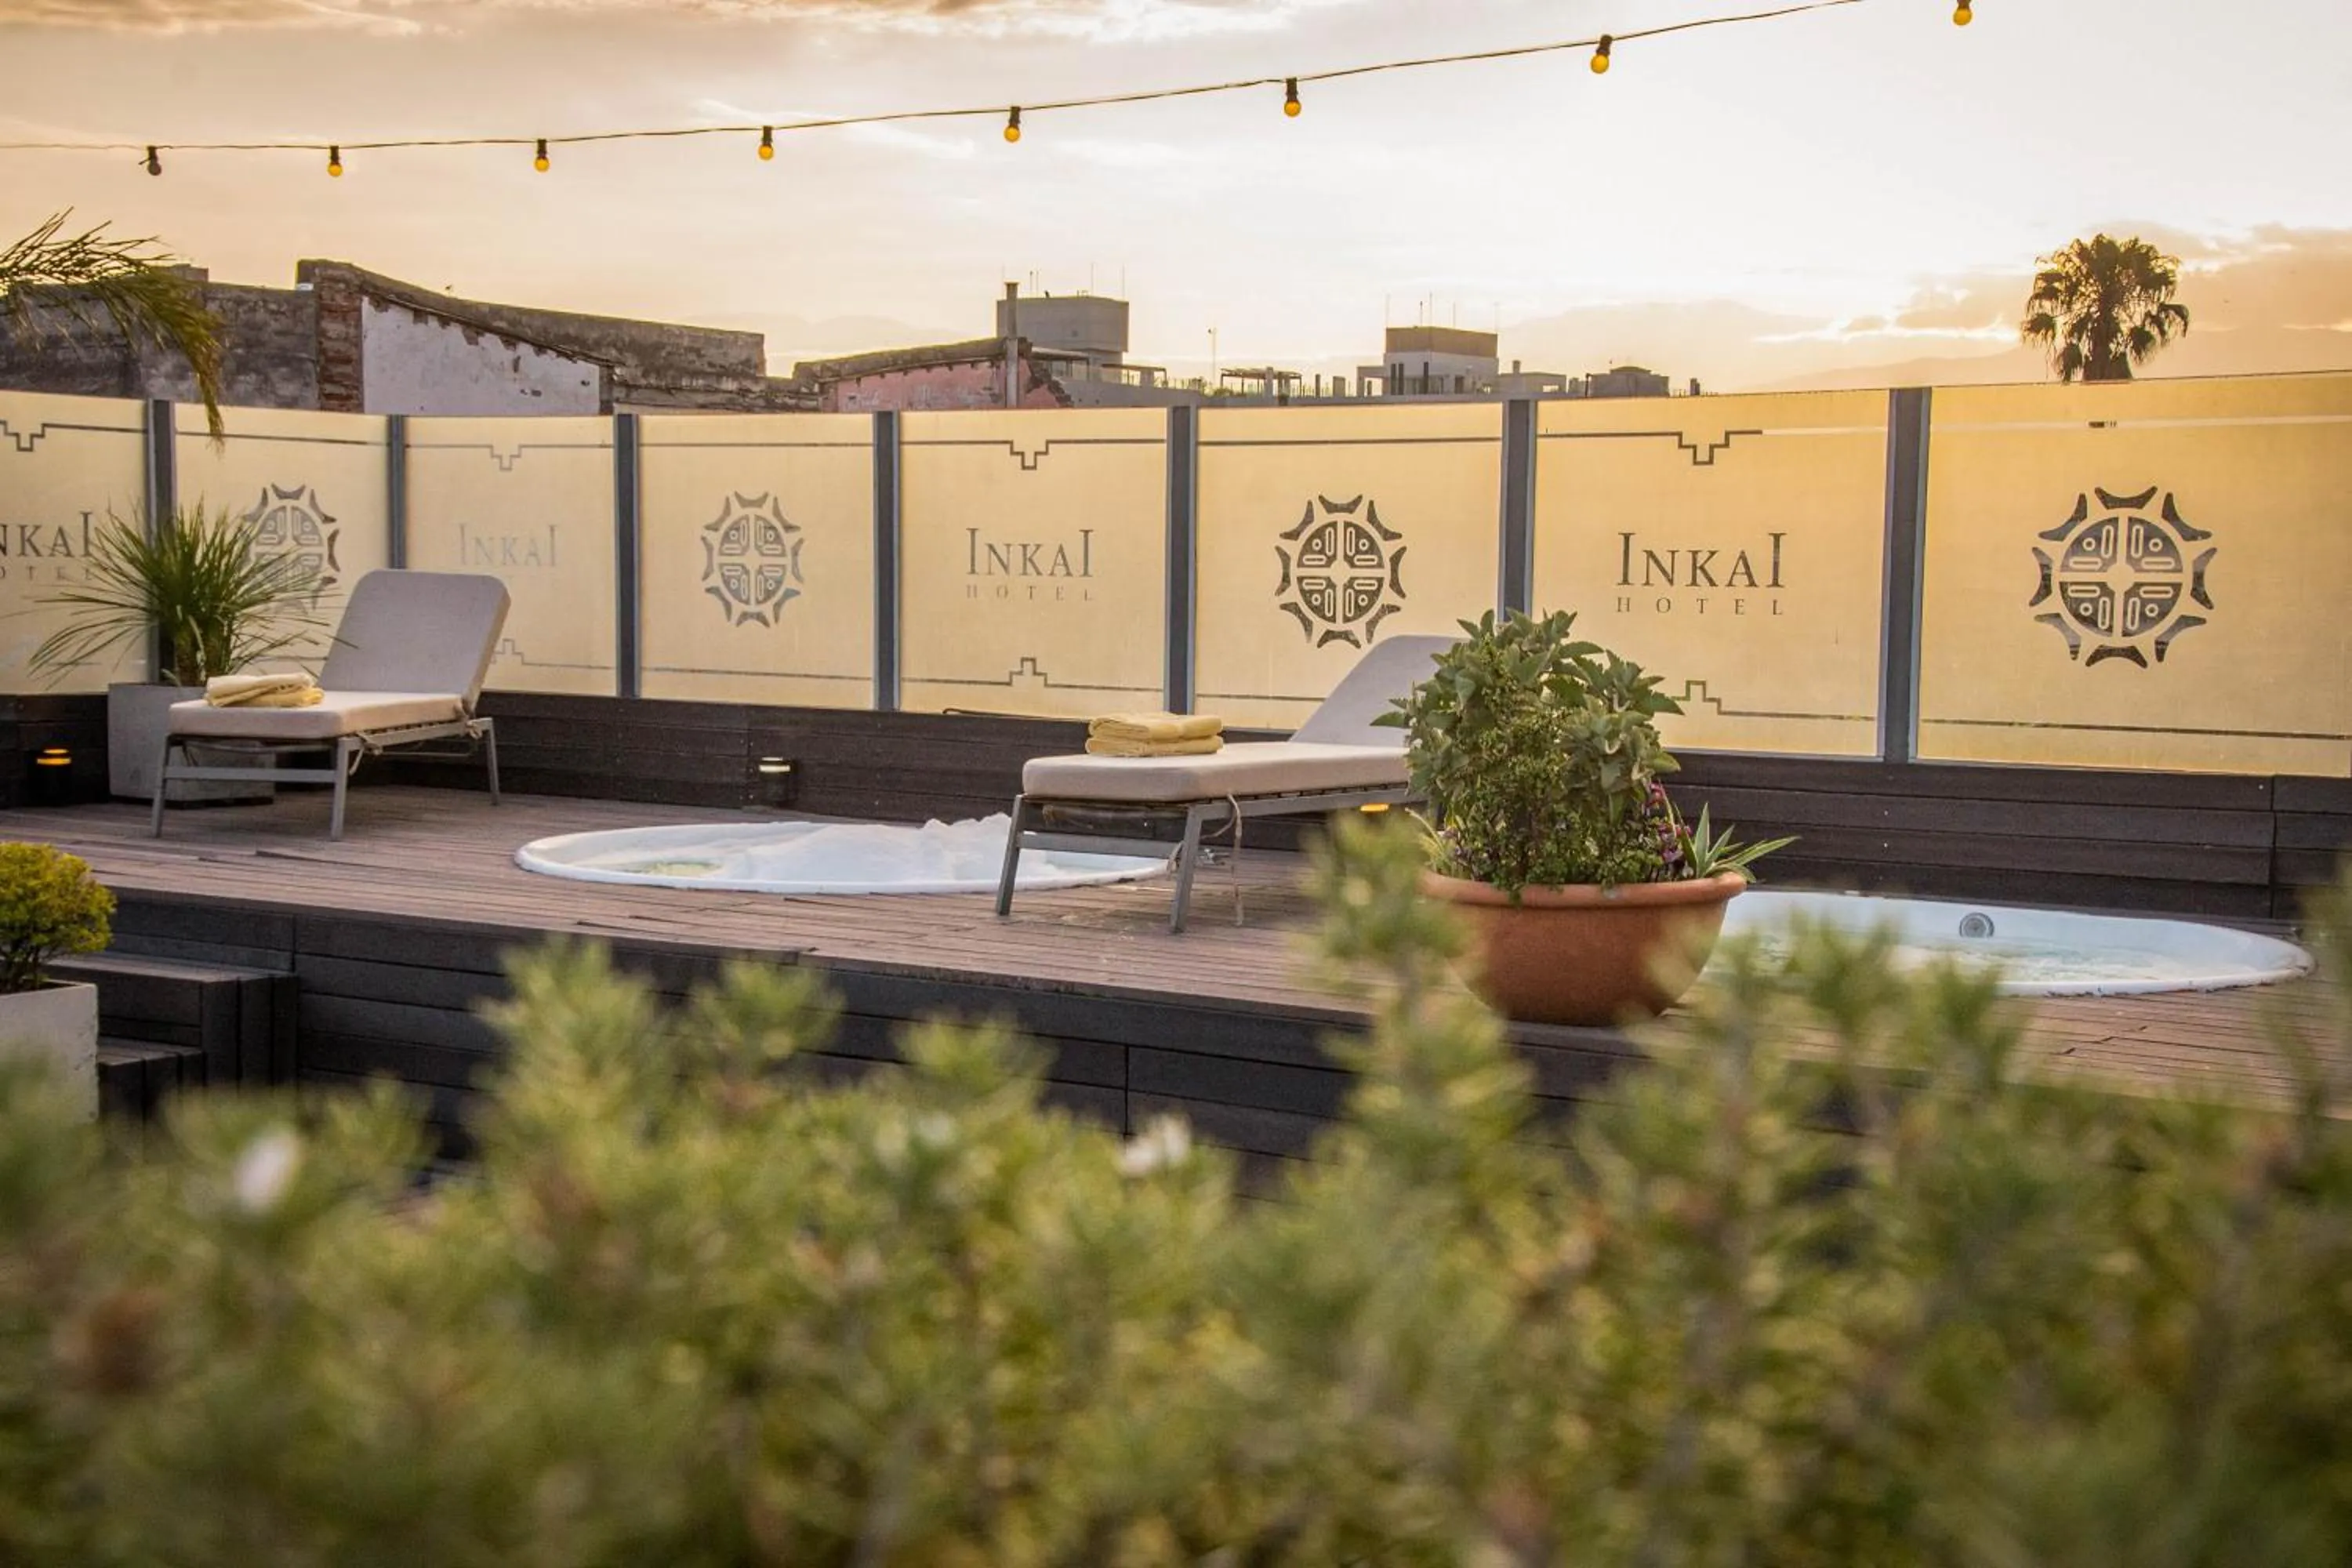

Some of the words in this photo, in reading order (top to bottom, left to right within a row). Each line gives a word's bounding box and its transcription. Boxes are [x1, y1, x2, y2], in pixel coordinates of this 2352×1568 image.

[0, 510, 93, 557] KAI
[459, 523, 558, 567] INKAI
[966, 528, 1094, 577] INKAI
[1616, 532, 1788, 588] INKAI
[967, 584, 1094, 601] HOTEL
[1616, 597, 1784, 615] HOTEL
